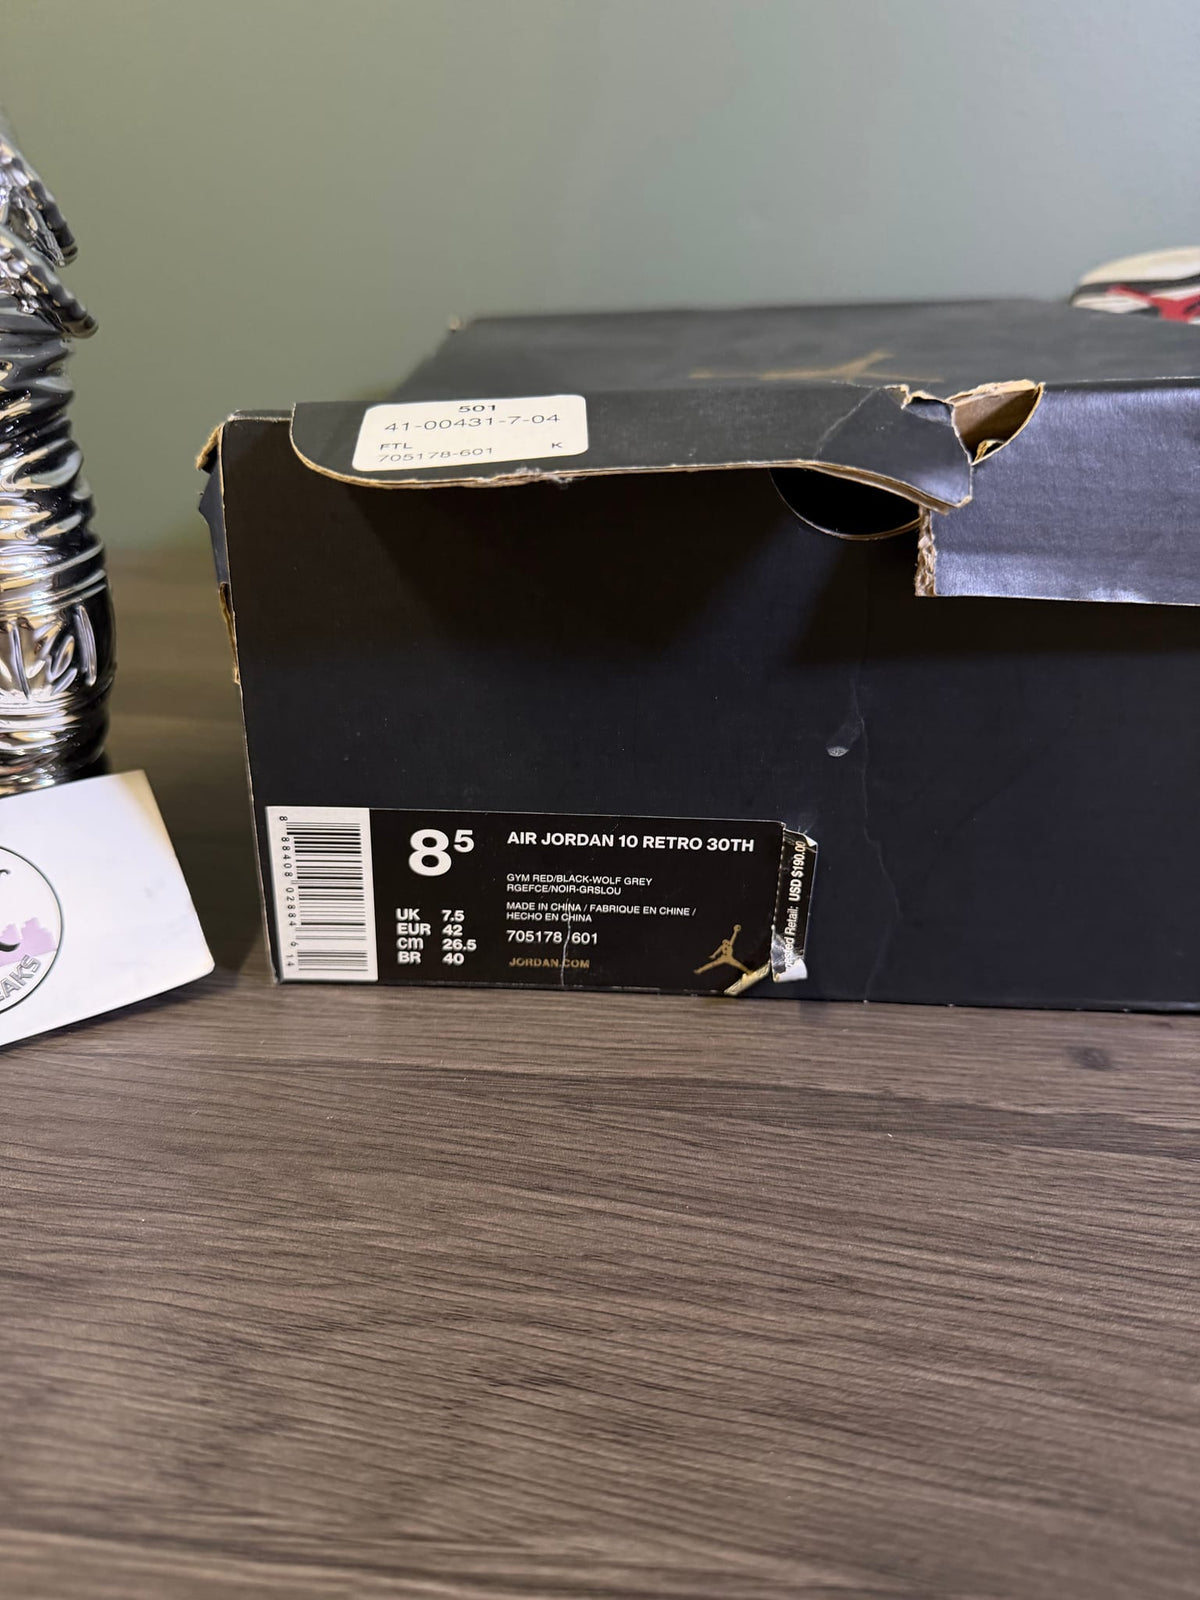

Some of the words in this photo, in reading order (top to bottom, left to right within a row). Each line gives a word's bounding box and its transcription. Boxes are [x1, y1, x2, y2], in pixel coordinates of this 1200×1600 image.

[458, 405, 496, 413] 501
[384, 414, 560, 432] 41-00431-7-04
[379, 442, 413, 450] FTL
[551, 441, 563, 449] K
[377, 447, 493, 463] 705178-601
[507, 831, 538, 845] AIR
[541, 832, 614, 847] JORDAN
[618, 834, 639, 848] 10
[643, 835, 703, 851] RETRO
[706, 838, 755, 852] 30TH
[281, 836, 294, 877] 88408
[790, 841, 806, 877] $190.00
[506, 873, 530, 882] GYM
[532, 874, 622, 885] RED/BLACK-WOLF
[623, 877, 653, 886] GREY
[506, 883, 621, 895] RGEFCE/NOIR-GRSLOU
[788, 879, 802, 902] USD
[285, 886, 297, 927] 02884
[506, 902, 535, 911] MADE
[538, 902, 548, 911] IN
[550, 903, 581, 912] CHINA
[589, 904, 640, 914] FABRIQUE
[643, 906, 656, 915] EN
[659, 907, 690, 916] CHINE
[396, 908, 421, 921] UK
[441, 909, 465, 922] 7.5
[506, 912, 542, 920] HECHO
[545, 913, 559, 921] EN
[561, 914, 592, 923] CHINA
[784, 906, 799, 935] Retail:
[396, 923, 432, 935] EUR
[442, 924, 463, 936] 42
[442, 938, 477, 950] 26.5
[506, 929, 563, 943] 705178
[571, 932, 598, 945] 601
[397, 951, 422, 964] BR
[442, 952, 465, 965] 40
[508, 957, 590, 969] JORDAN.COM
